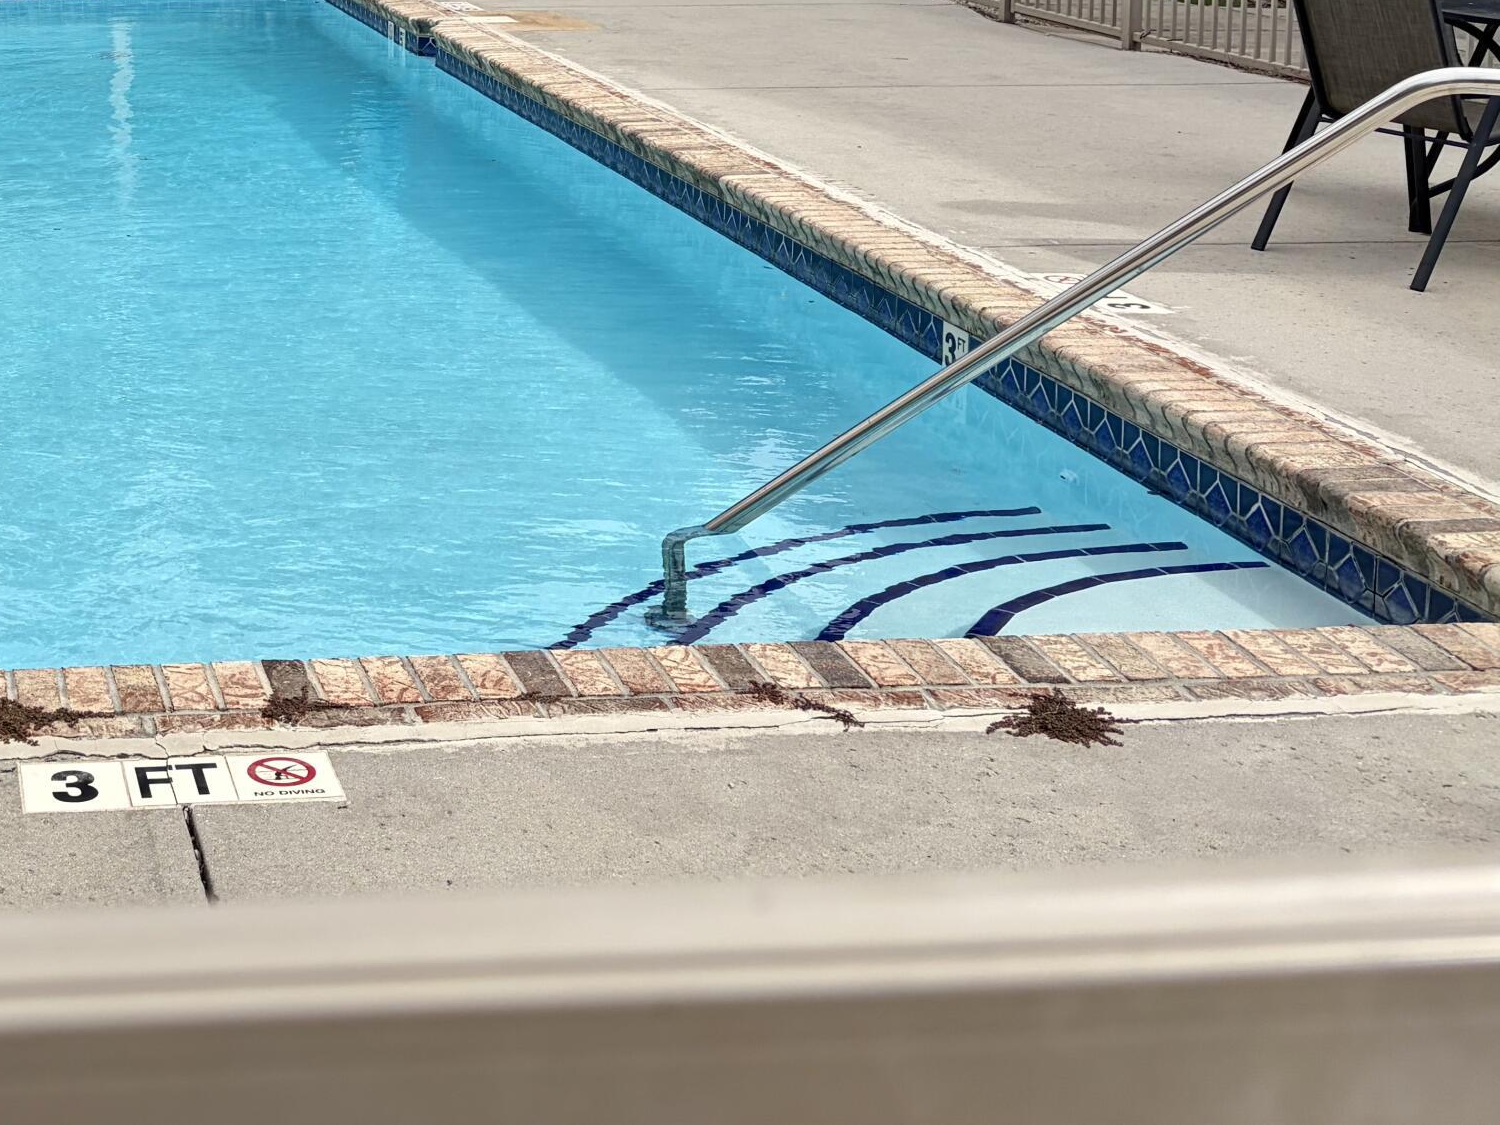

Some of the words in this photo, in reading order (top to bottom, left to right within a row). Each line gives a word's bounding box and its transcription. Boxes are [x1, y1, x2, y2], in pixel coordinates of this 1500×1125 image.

[945, 331, 957, 367] 3
[957, 337, 966, 353] FT
[50, 769, 99, 803] 3
[134, 762, 218, 799] FT
